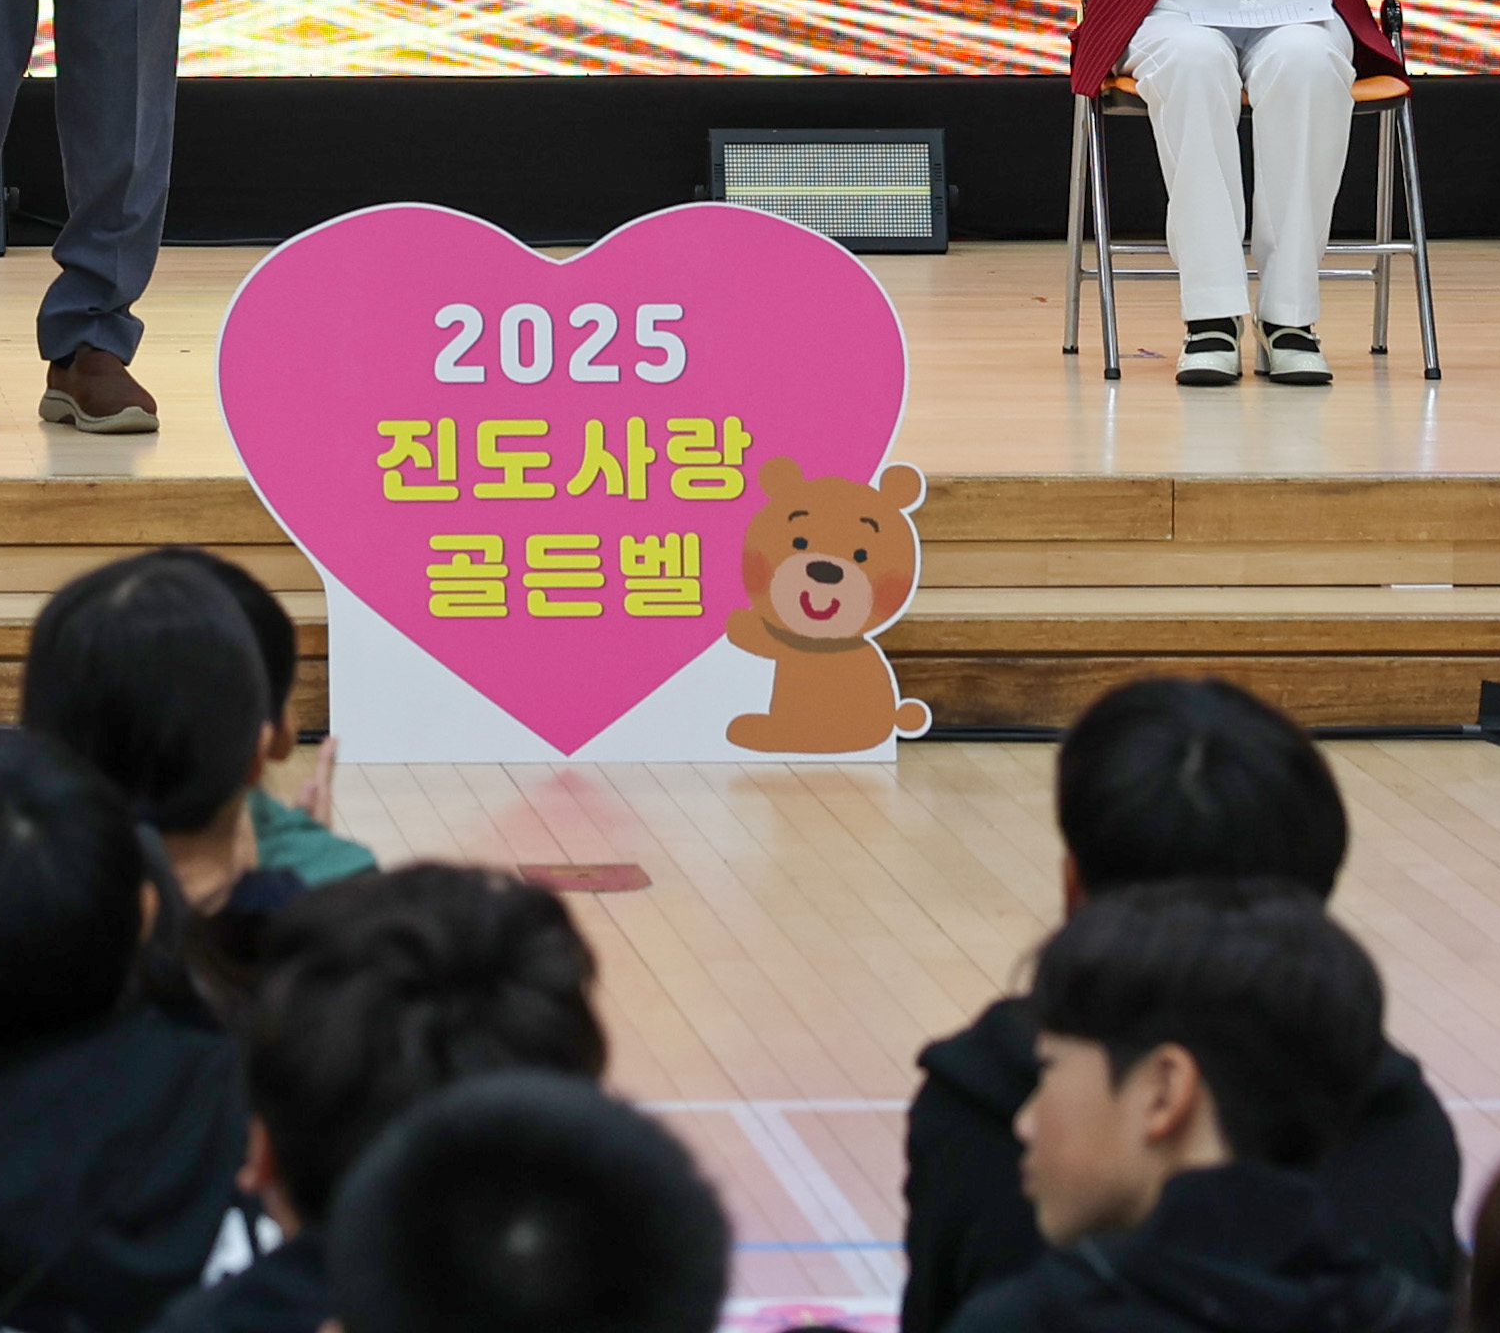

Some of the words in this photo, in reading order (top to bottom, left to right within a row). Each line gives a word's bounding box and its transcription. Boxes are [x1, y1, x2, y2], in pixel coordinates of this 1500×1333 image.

[433, 302, 688, 384] 2025
[375, 415, 753, 502] 진도사랑
[425, 532, 704, 619] 골든벨
